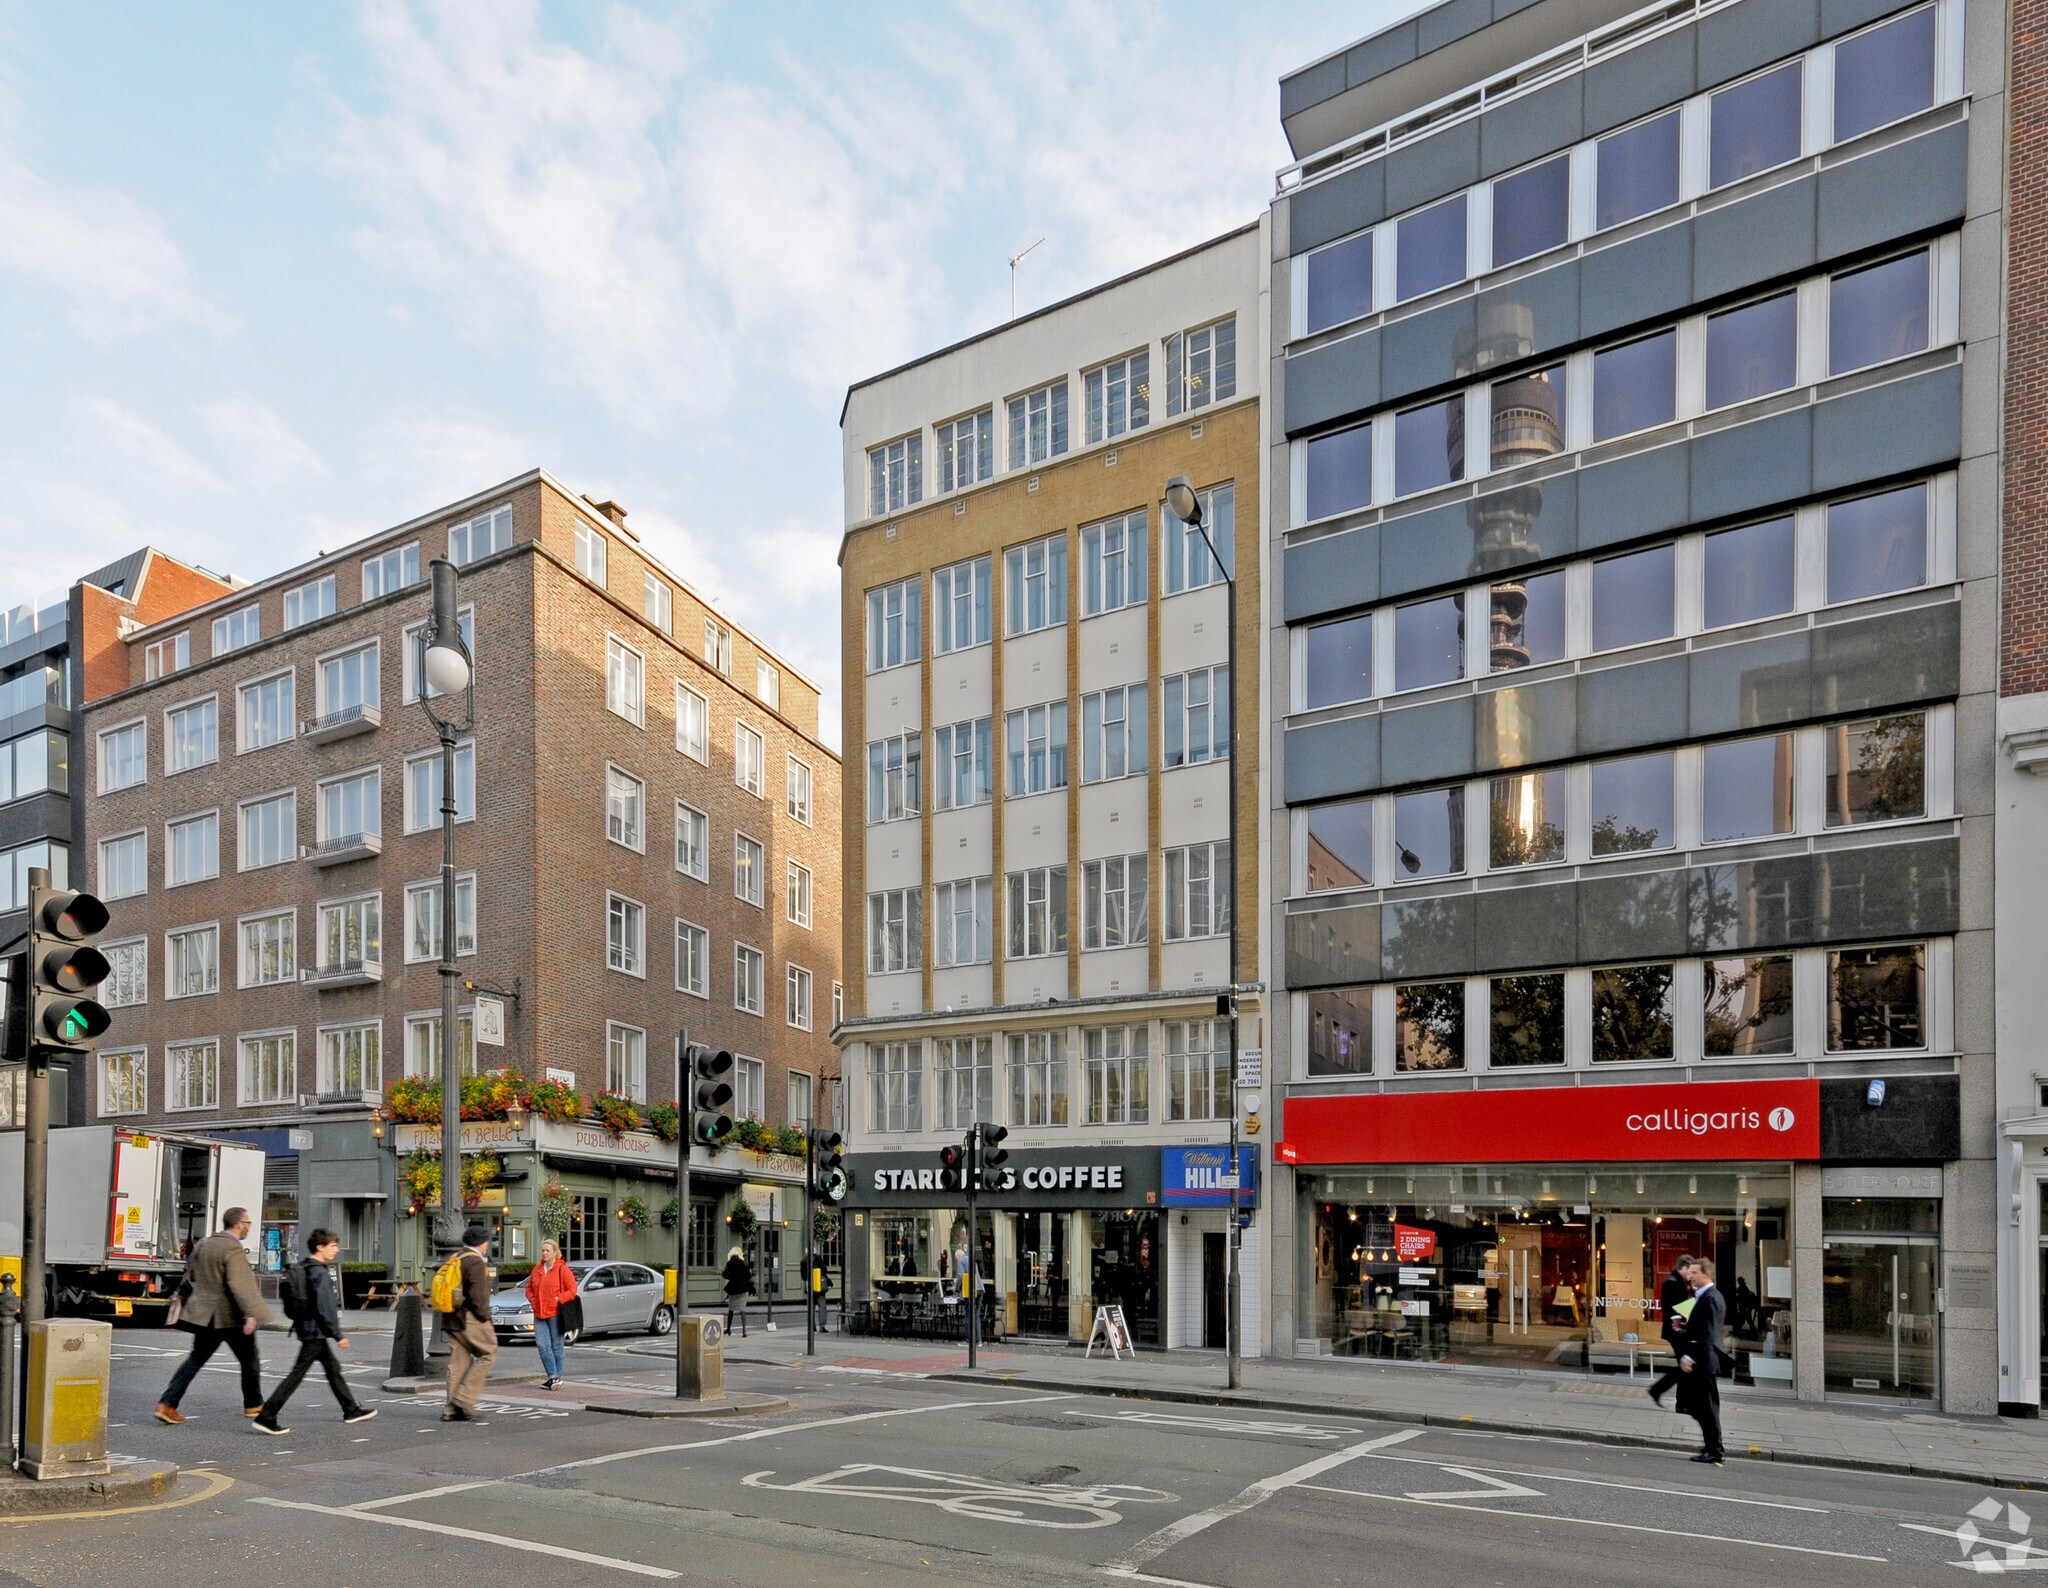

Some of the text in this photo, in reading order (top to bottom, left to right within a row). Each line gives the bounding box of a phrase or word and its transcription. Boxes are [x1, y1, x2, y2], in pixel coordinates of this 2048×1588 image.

[1626, 1107, 1760, 1135] calligaris
[475, 1126, 514, 1145] BELLE
[575, 1130, 614, 1149] PUBLIC
[1183, 1150, 1226, 1166] William
[1022, 1165, 1123, 1190] COFFEE
[1185, 1167, 1223, 1189] HILL
[1660, 1232, 1688, 1240] URBAN
[1595, 1296, 1625, 1308] NEW
